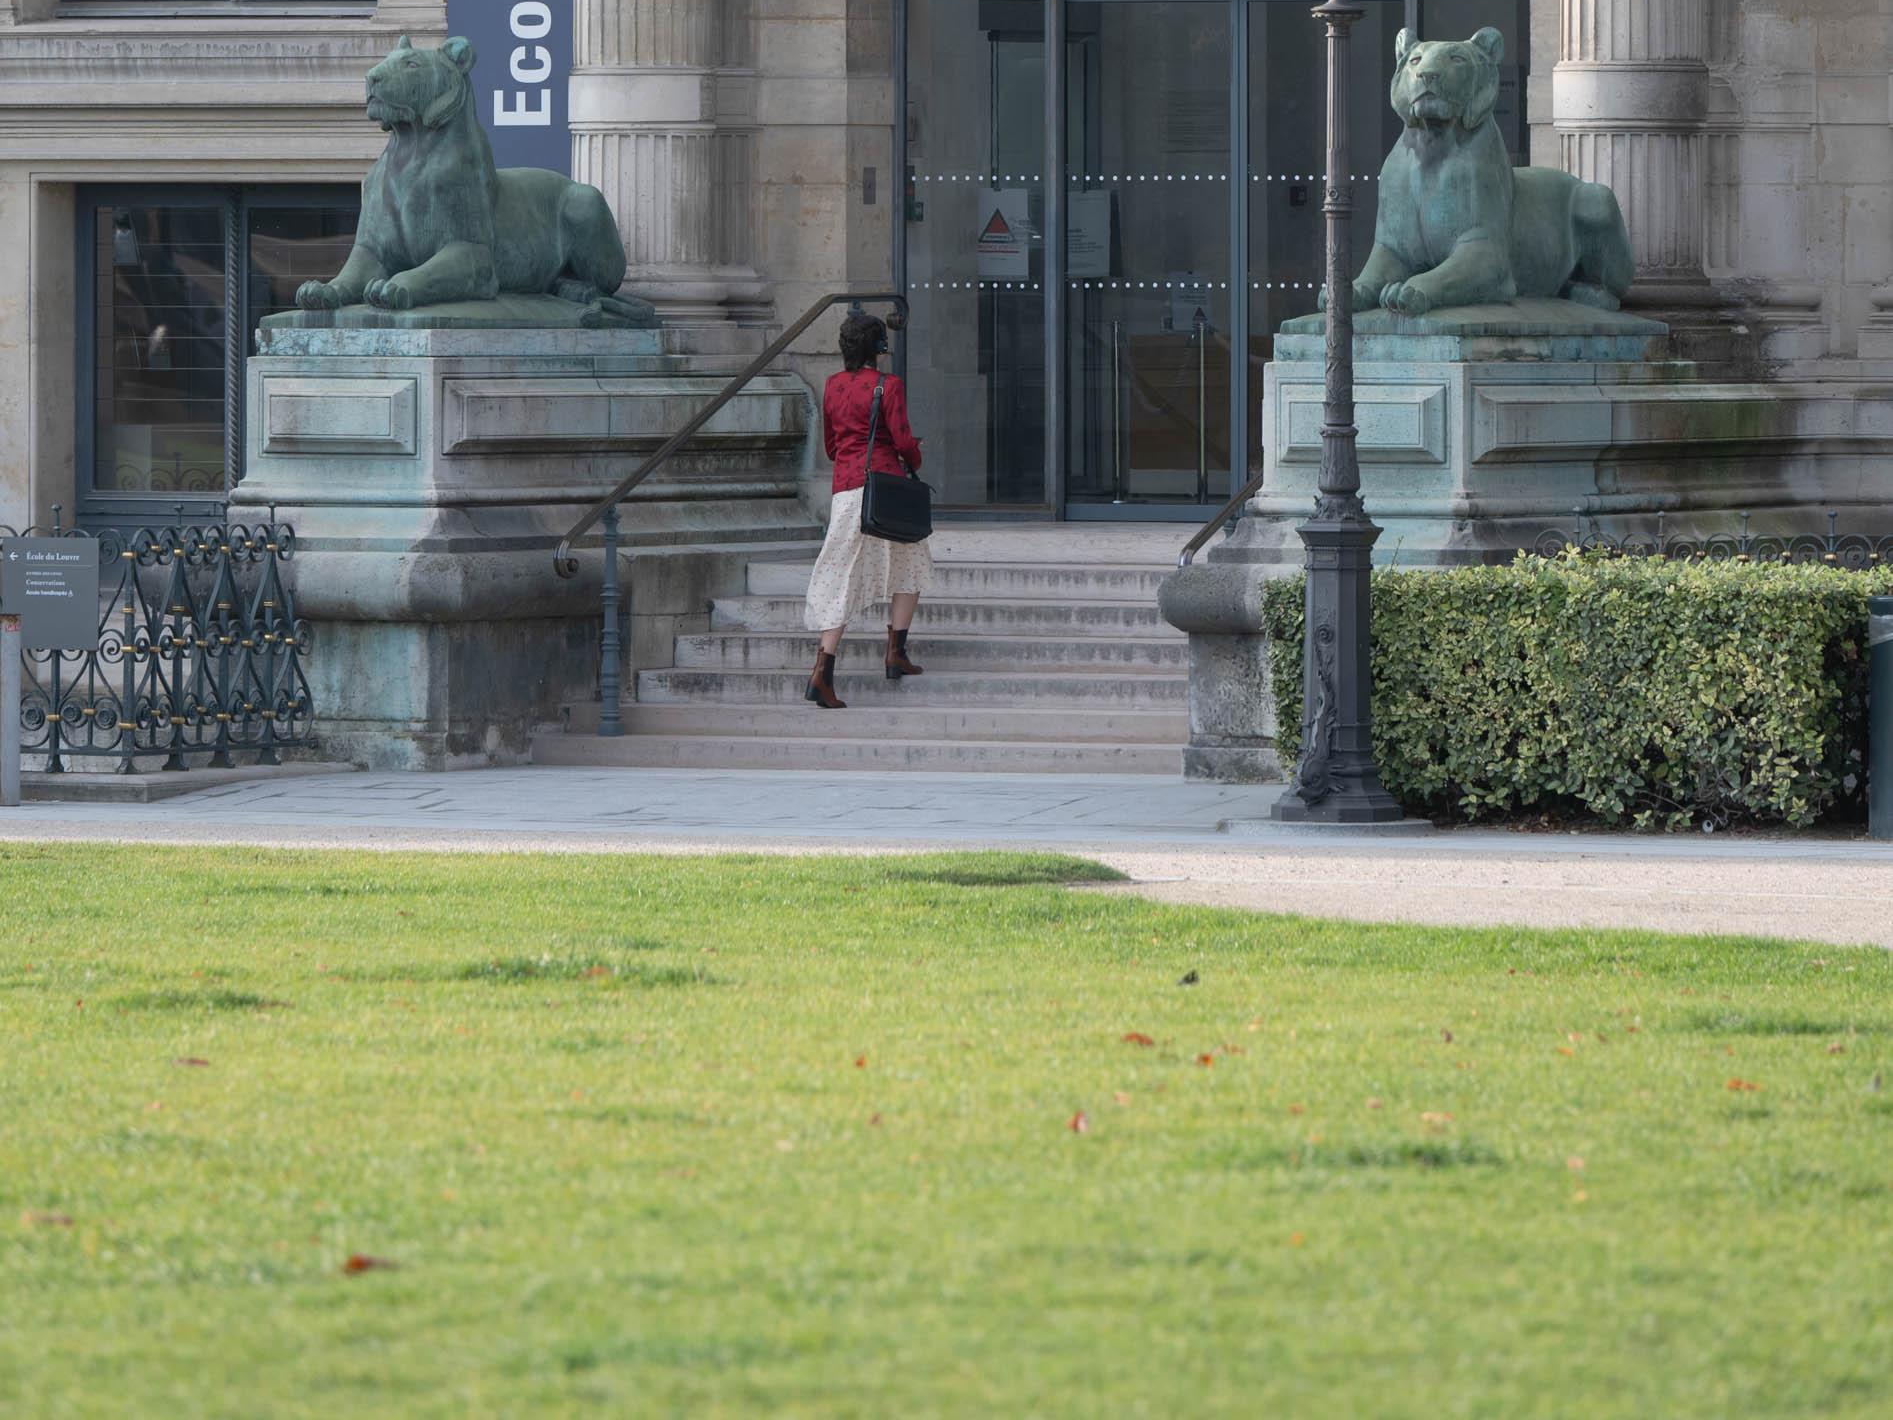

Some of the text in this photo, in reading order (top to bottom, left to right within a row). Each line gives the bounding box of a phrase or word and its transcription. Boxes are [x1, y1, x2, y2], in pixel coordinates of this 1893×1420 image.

[26, 551, 80, 561] École du Louvre
